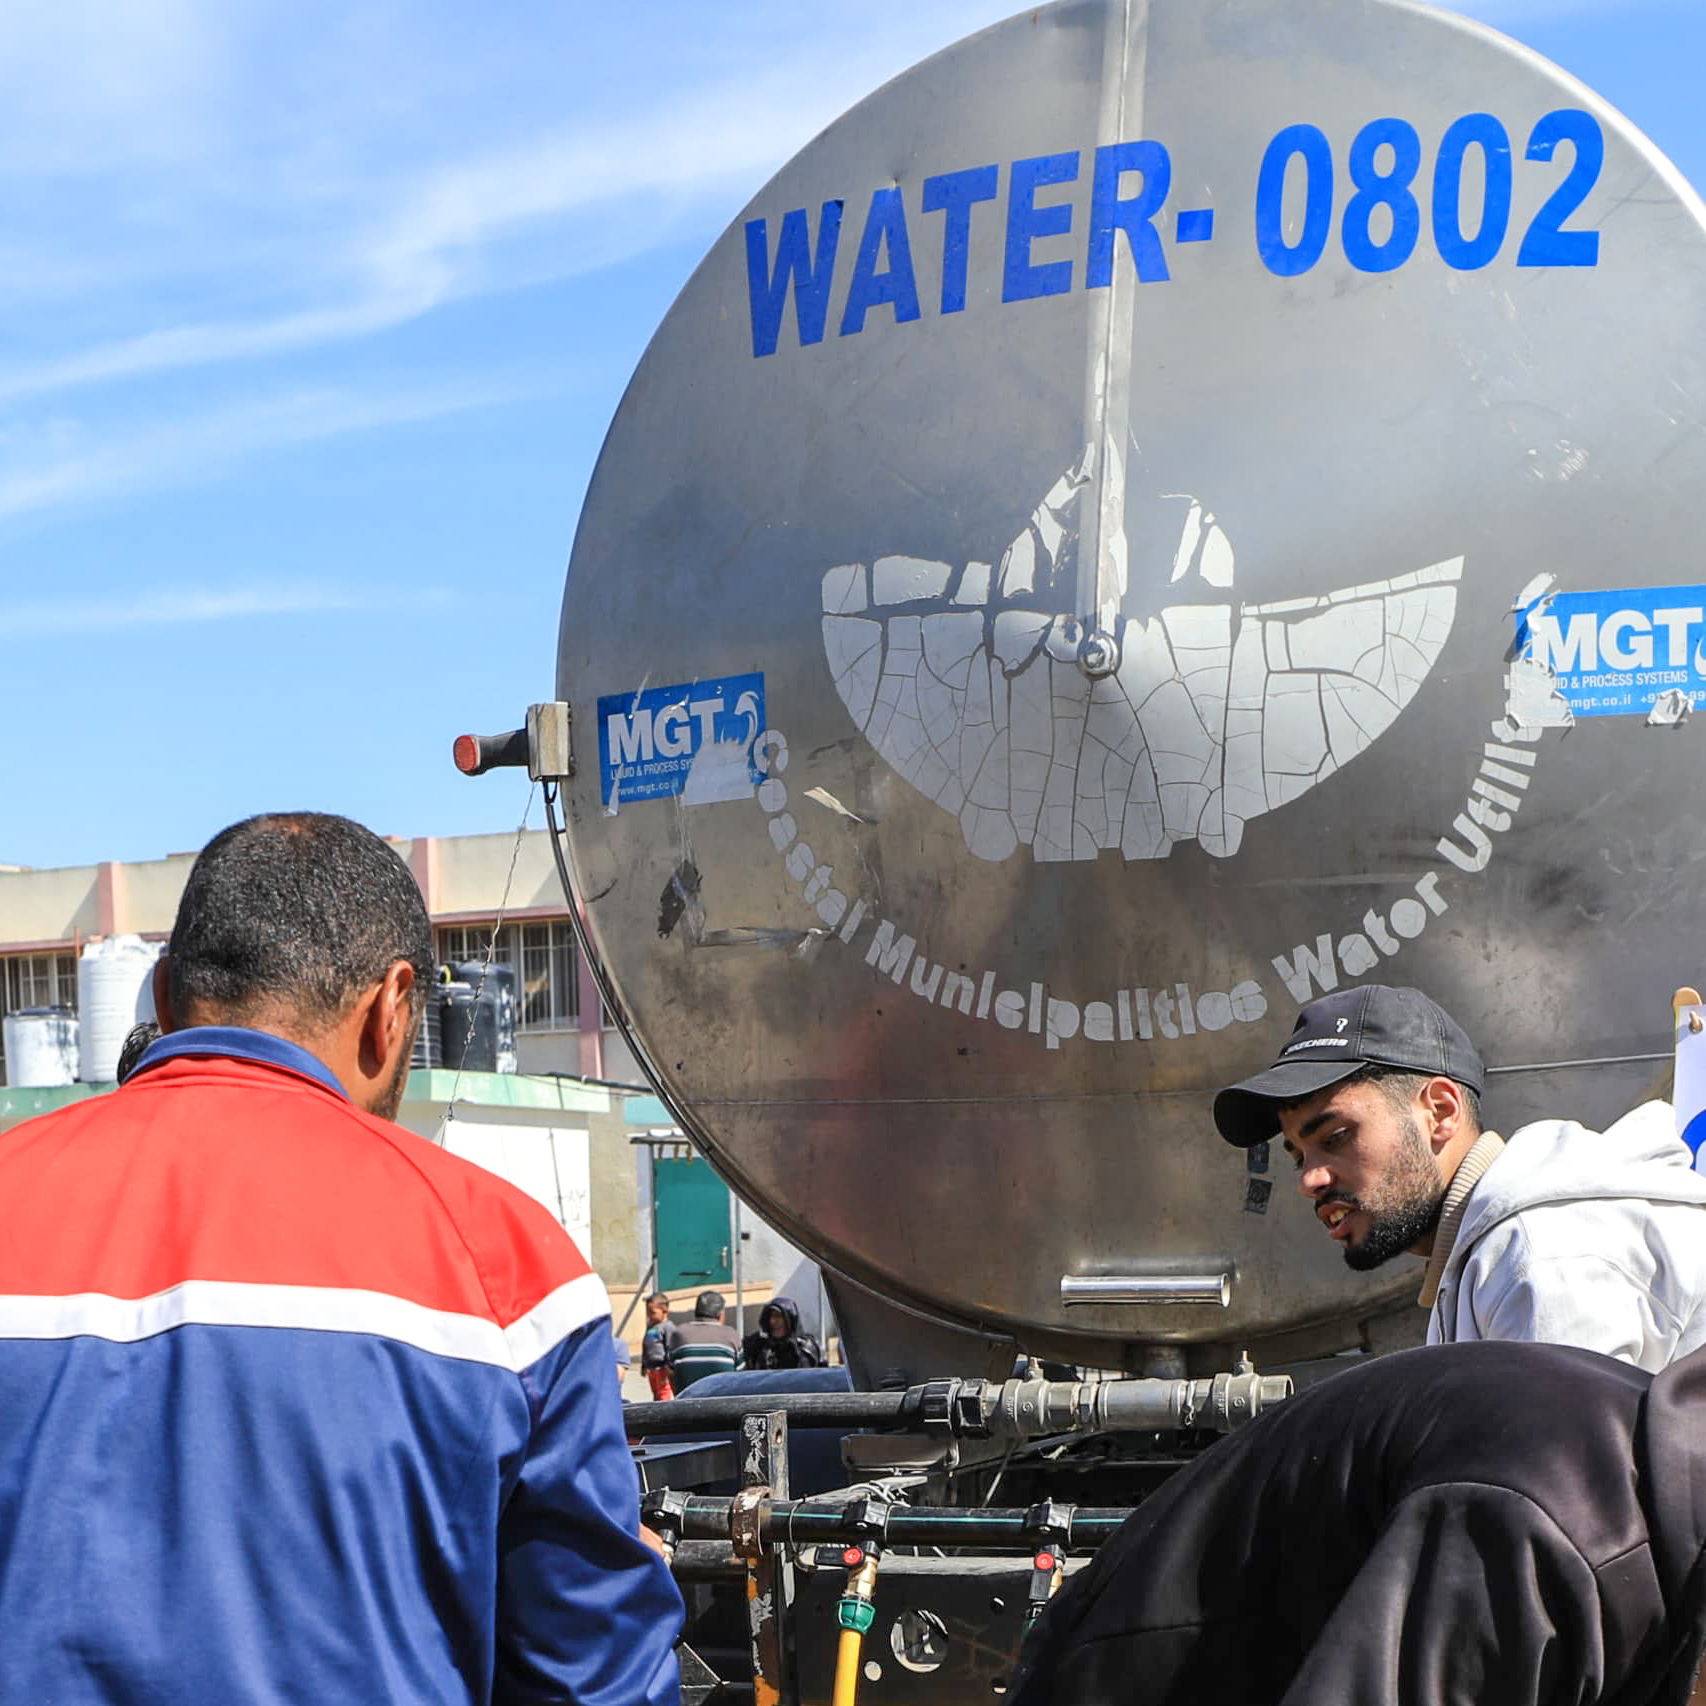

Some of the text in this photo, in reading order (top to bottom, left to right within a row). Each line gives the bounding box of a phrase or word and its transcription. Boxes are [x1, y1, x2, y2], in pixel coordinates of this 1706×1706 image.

[743, 108, 1606, 359] WATER- 0802
[1532, 607, 1703, 673] MGT
[1582, 673, 1633, 688] PROCESS
[1636, 670, 1688, 685] SYSTEMS
[607, 698, 725, 766] MGT
